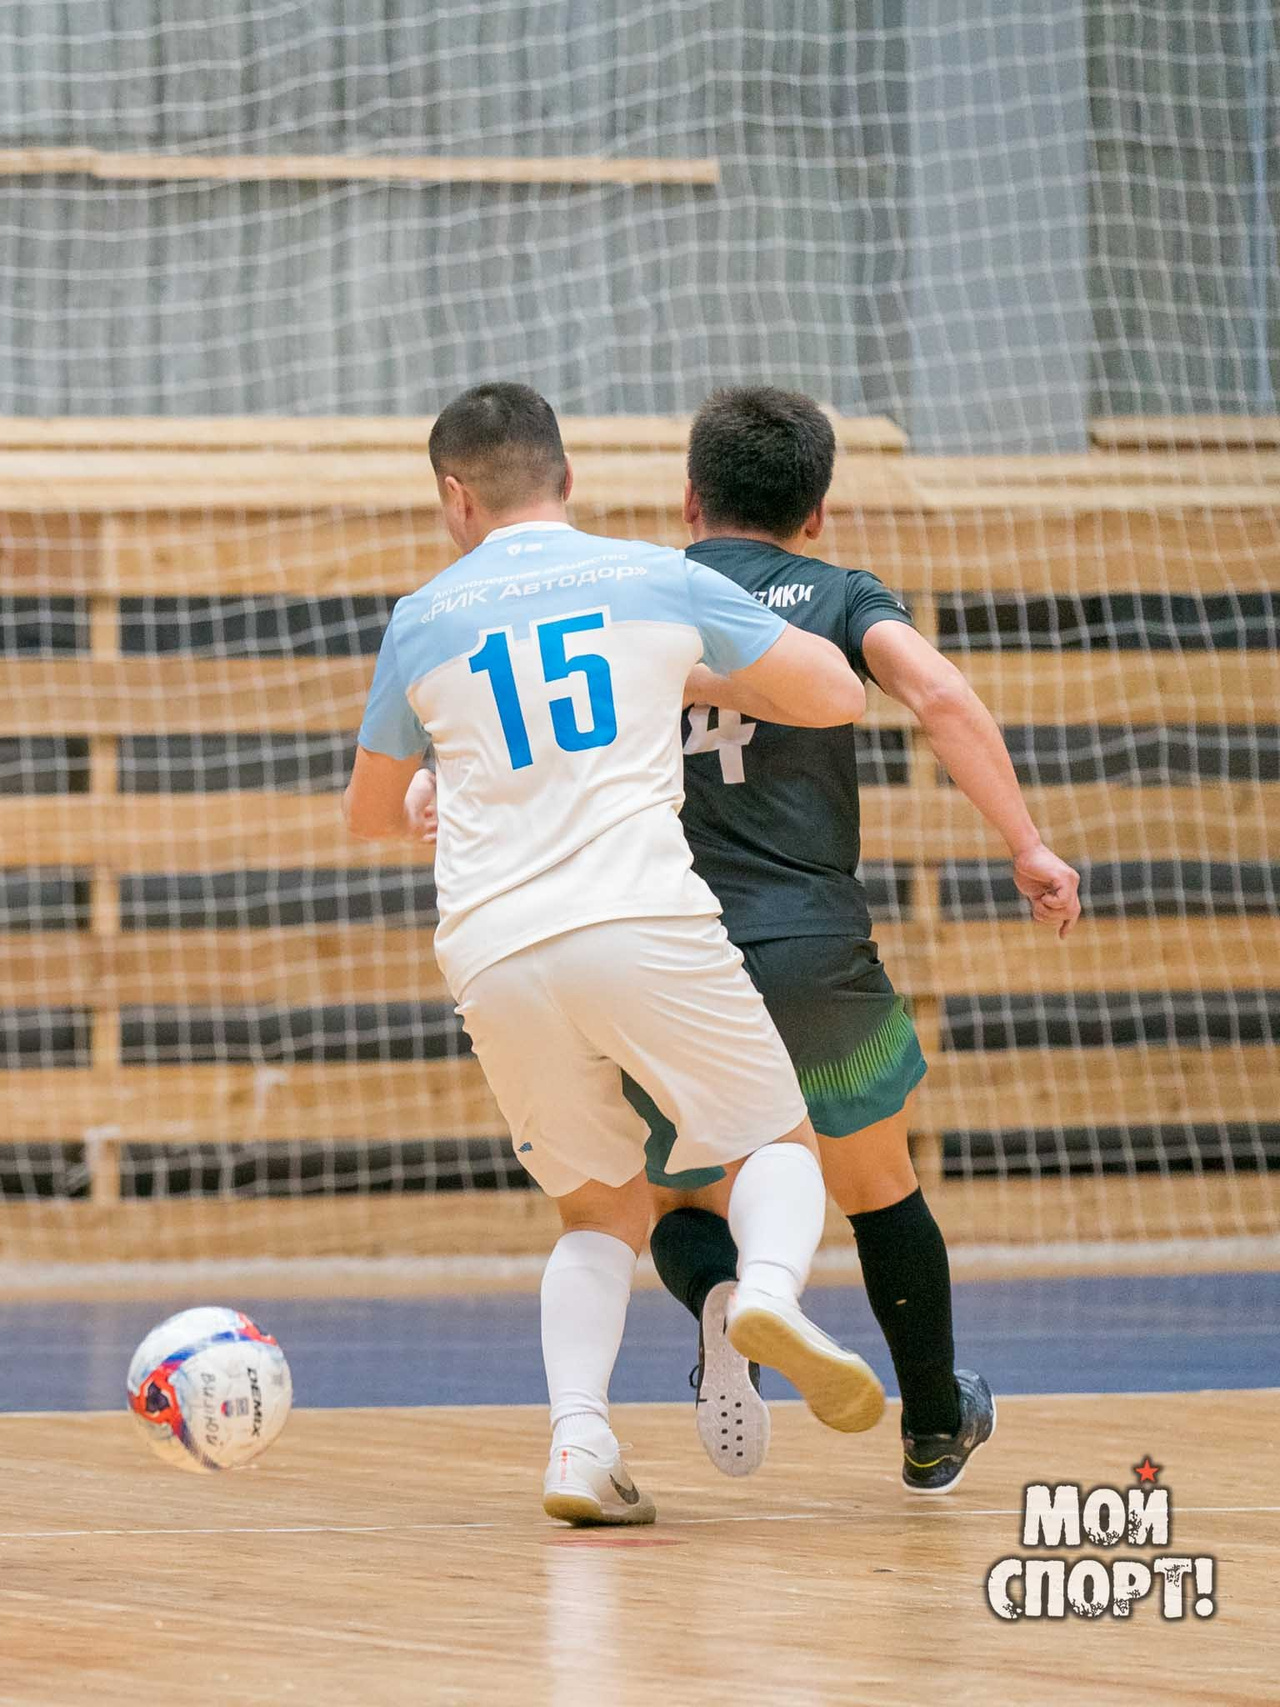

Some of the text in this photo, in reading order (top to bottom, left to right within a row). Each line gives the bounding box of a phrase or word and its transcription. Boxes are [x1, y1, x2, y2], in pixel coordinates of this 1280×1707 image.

[421, 565, 648, 624] «РИК Автодор»
[468, 611, 618, 770] 15
[683, 703, 757, 784] 4
[247, 1367, 262, 1437] DEMIX
